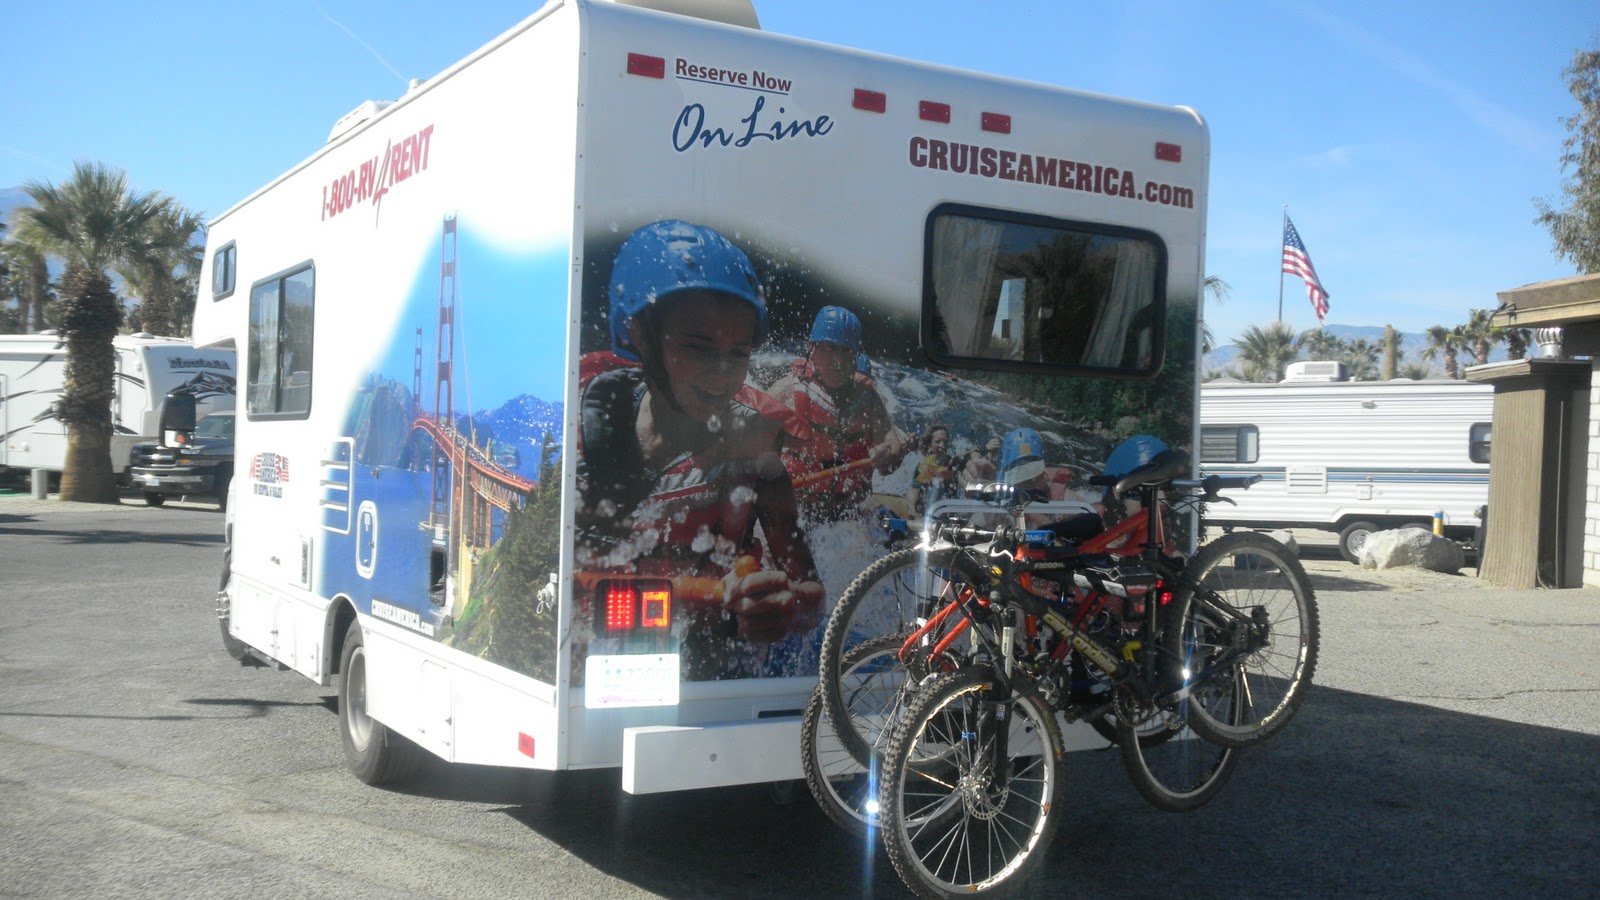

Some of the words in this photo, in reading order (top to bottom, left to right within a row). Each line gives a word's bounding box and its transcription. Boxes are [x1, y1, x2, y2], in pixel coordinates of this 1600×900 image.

[675, 58, 748, 85] Reserve
[752, 70, 793, 92] Now
[909, 136, 1194, 209] CRUISEAMERICA.com
